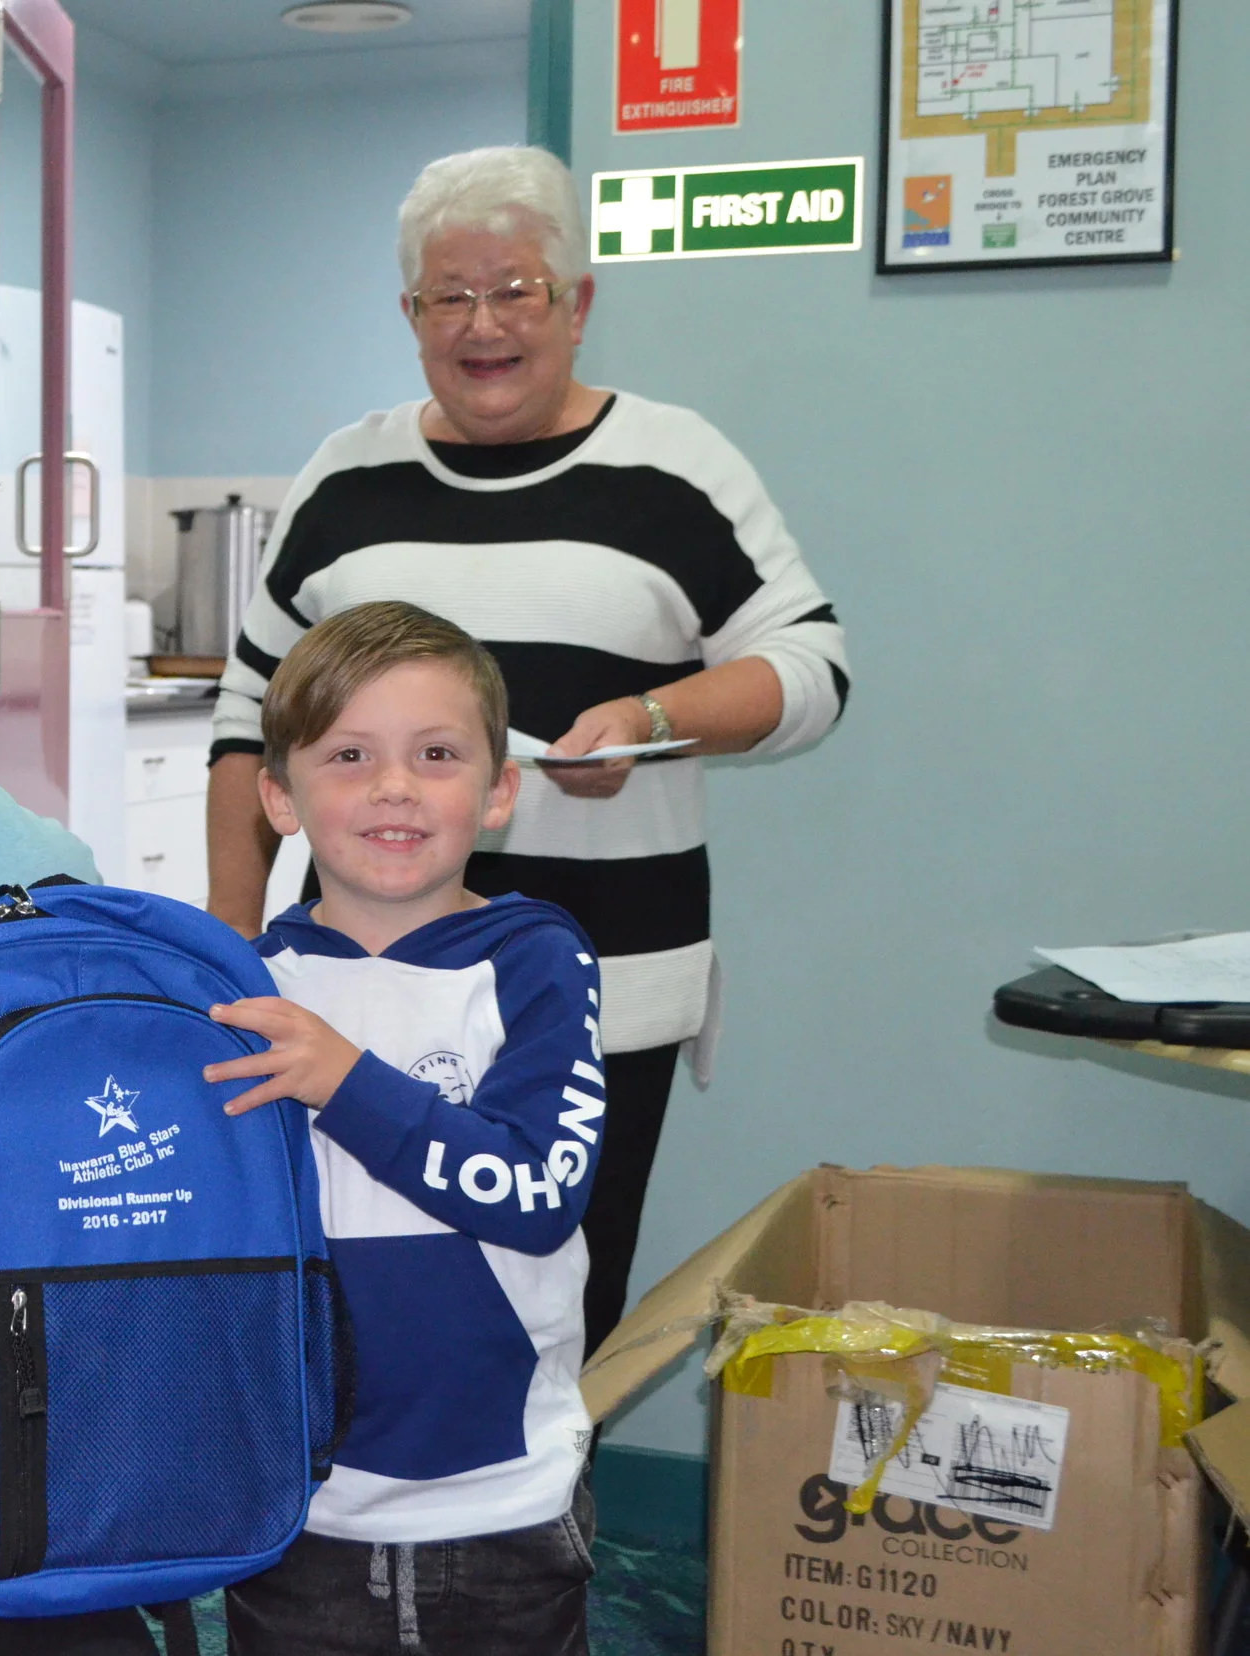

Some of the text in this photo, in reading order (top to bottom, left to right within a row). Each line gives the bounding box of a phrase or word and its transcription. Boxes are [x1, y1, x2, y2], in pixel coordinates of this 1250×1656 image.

[660, 76, 695, 94] FIRE
[622, 96, 735, 120] EXTINGUISHER
[1048, 148, 1147, 168] EMERGENCY
[1076, 170, 1117, 186] PLAN
[692, 188, 844, 229] FIRST AID
[1037, 187, 1155, 209] FOREST GROVE
[1046, 208, 1146, 228] COMMUNITY
[1064, 228, 1125, 246] CENTRE
[118, 1141, 147, 1159] Blue
[149, 1124, 181, 1146] Stars
[73, 1144, 175, 1184] Athletic Club Inc
[58, 1189, 193, 1210] Divisional Runner Up
[83, 1214, 119, 1229] 2016
[132, 1210, 167, 1225] 2017
[881, 1535, 1029, 1571] COLLECTION
